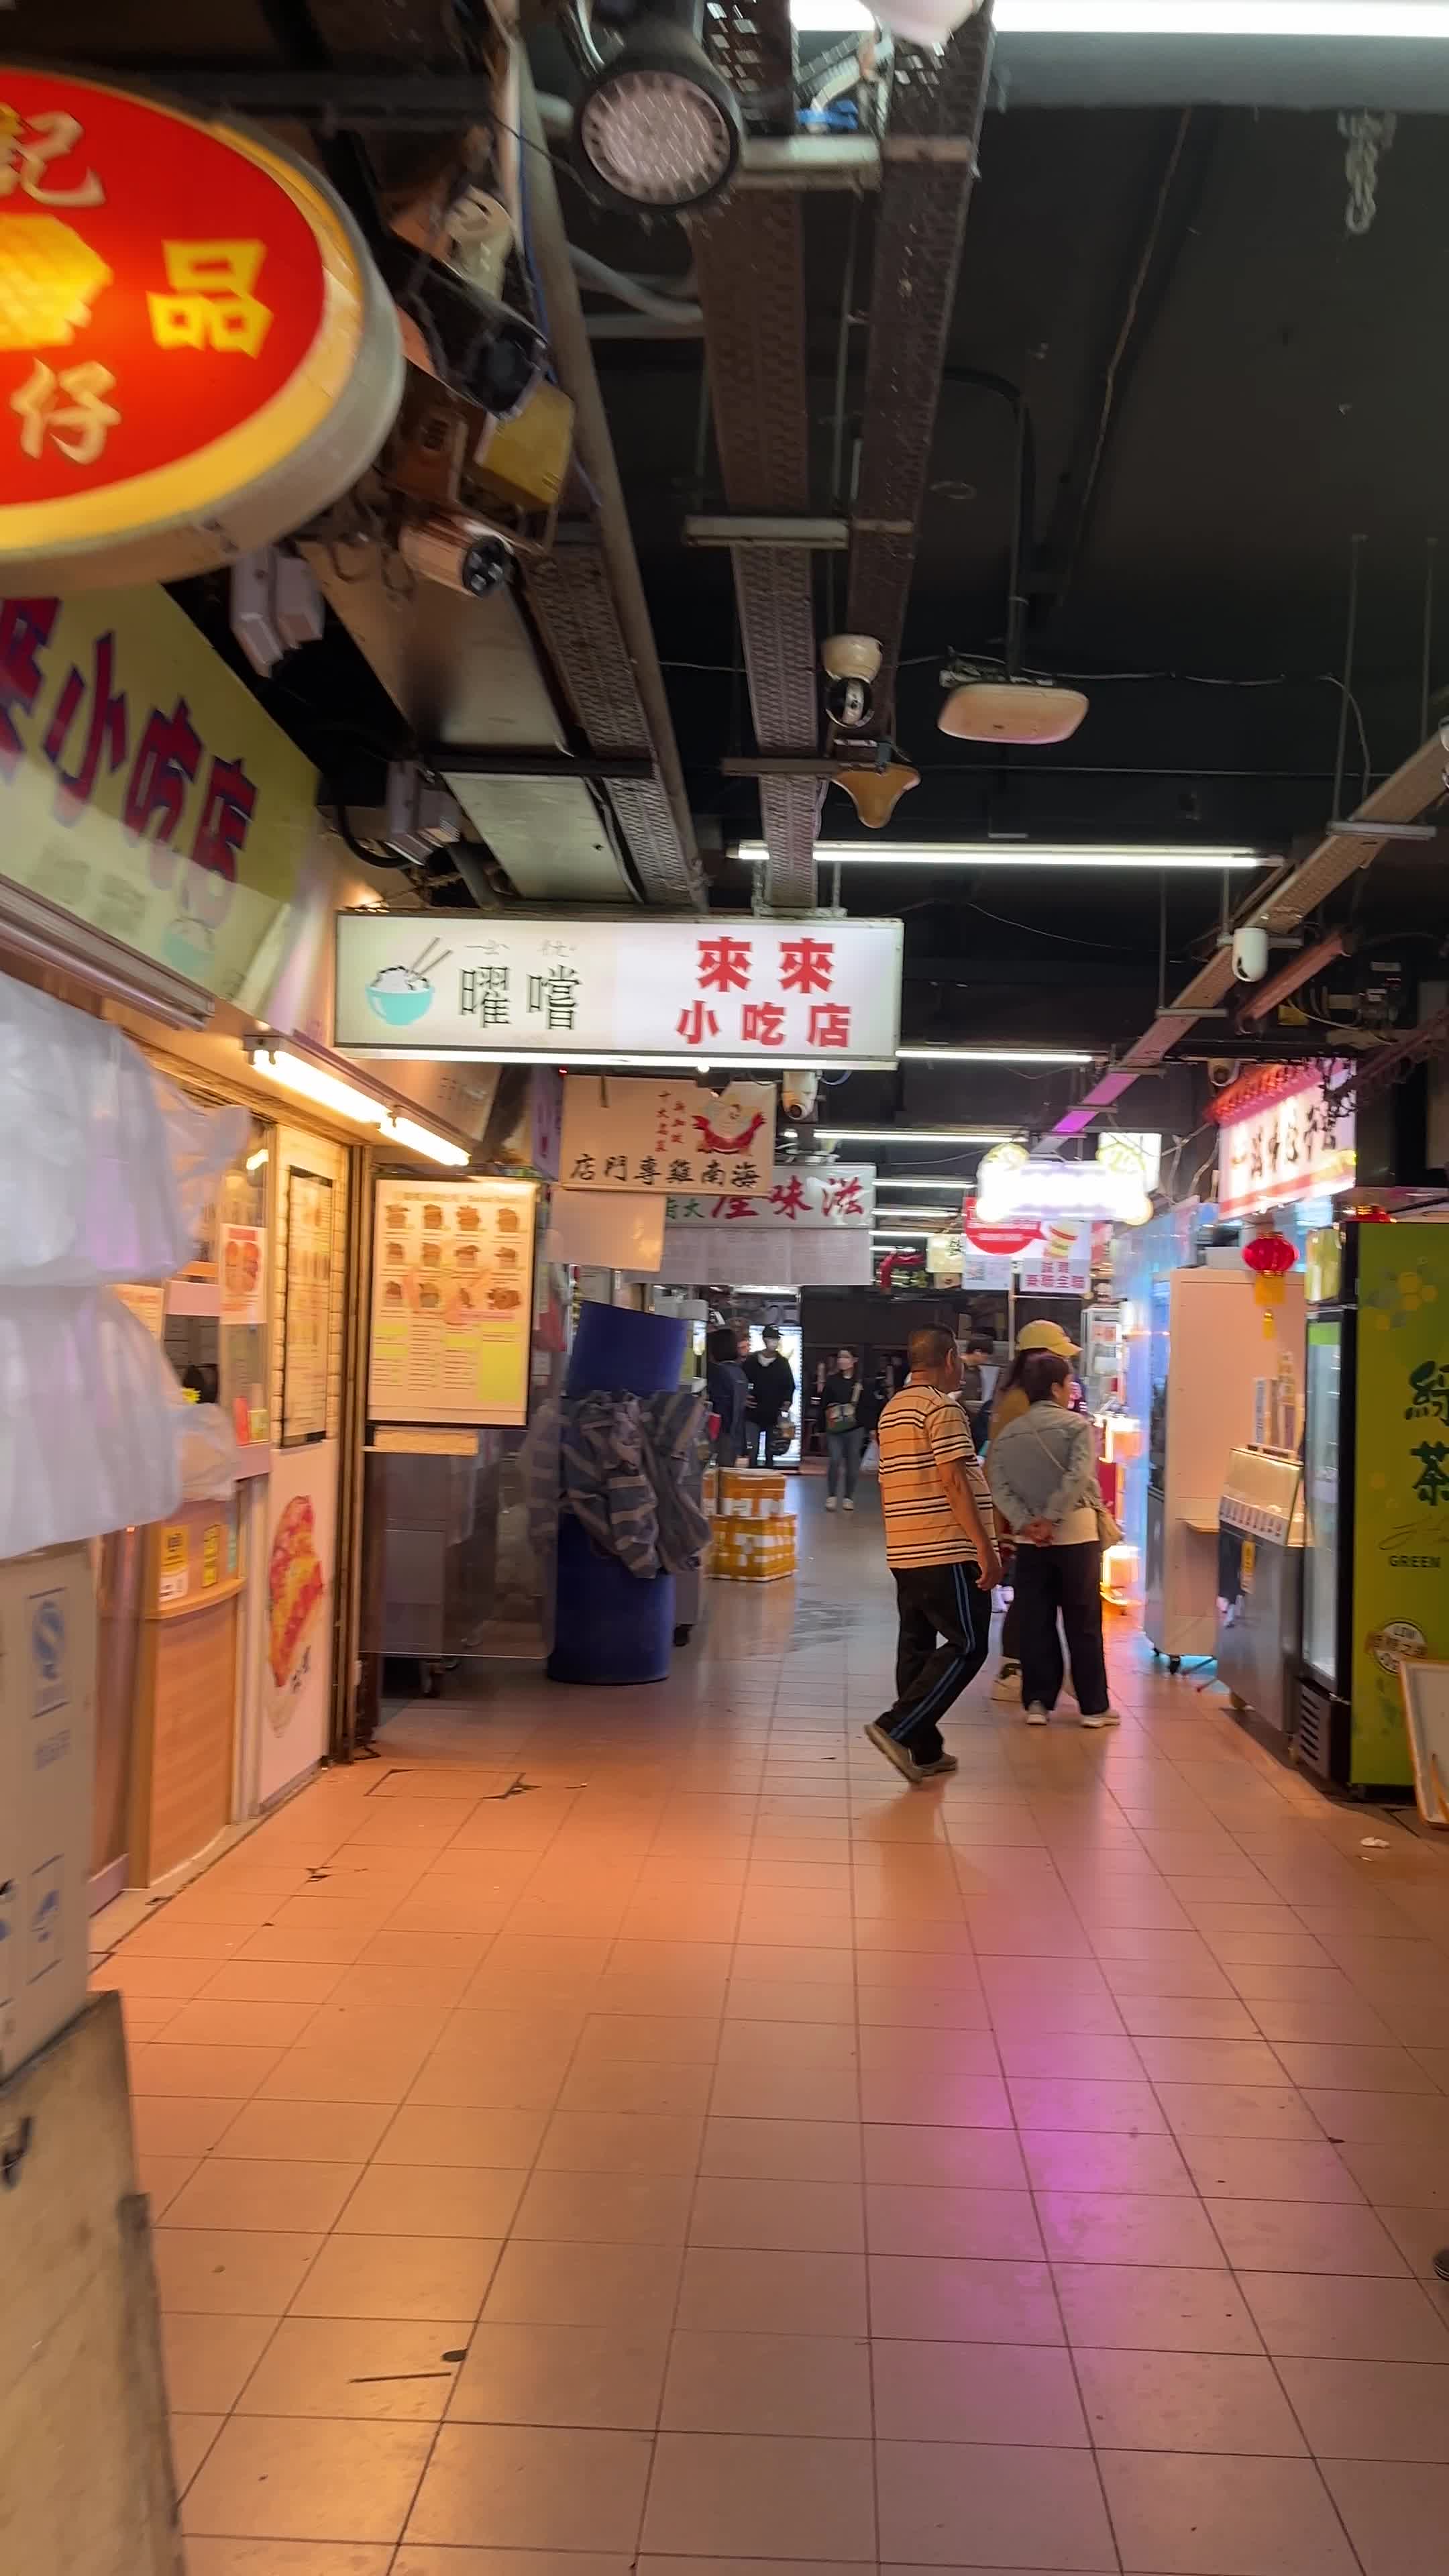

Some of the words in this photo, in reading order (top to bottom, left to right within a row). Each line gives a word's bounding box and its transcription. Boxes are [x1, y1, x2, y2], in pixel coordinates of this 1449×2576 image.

[146, 238, 274, 359] 品
[9, 356, 122, 466] 仔
[696, 936, 835, 994] 來來
[676, 1000, 853, 1049] 小吃店
[1389, 1554, 1441, 1568] GREEN
